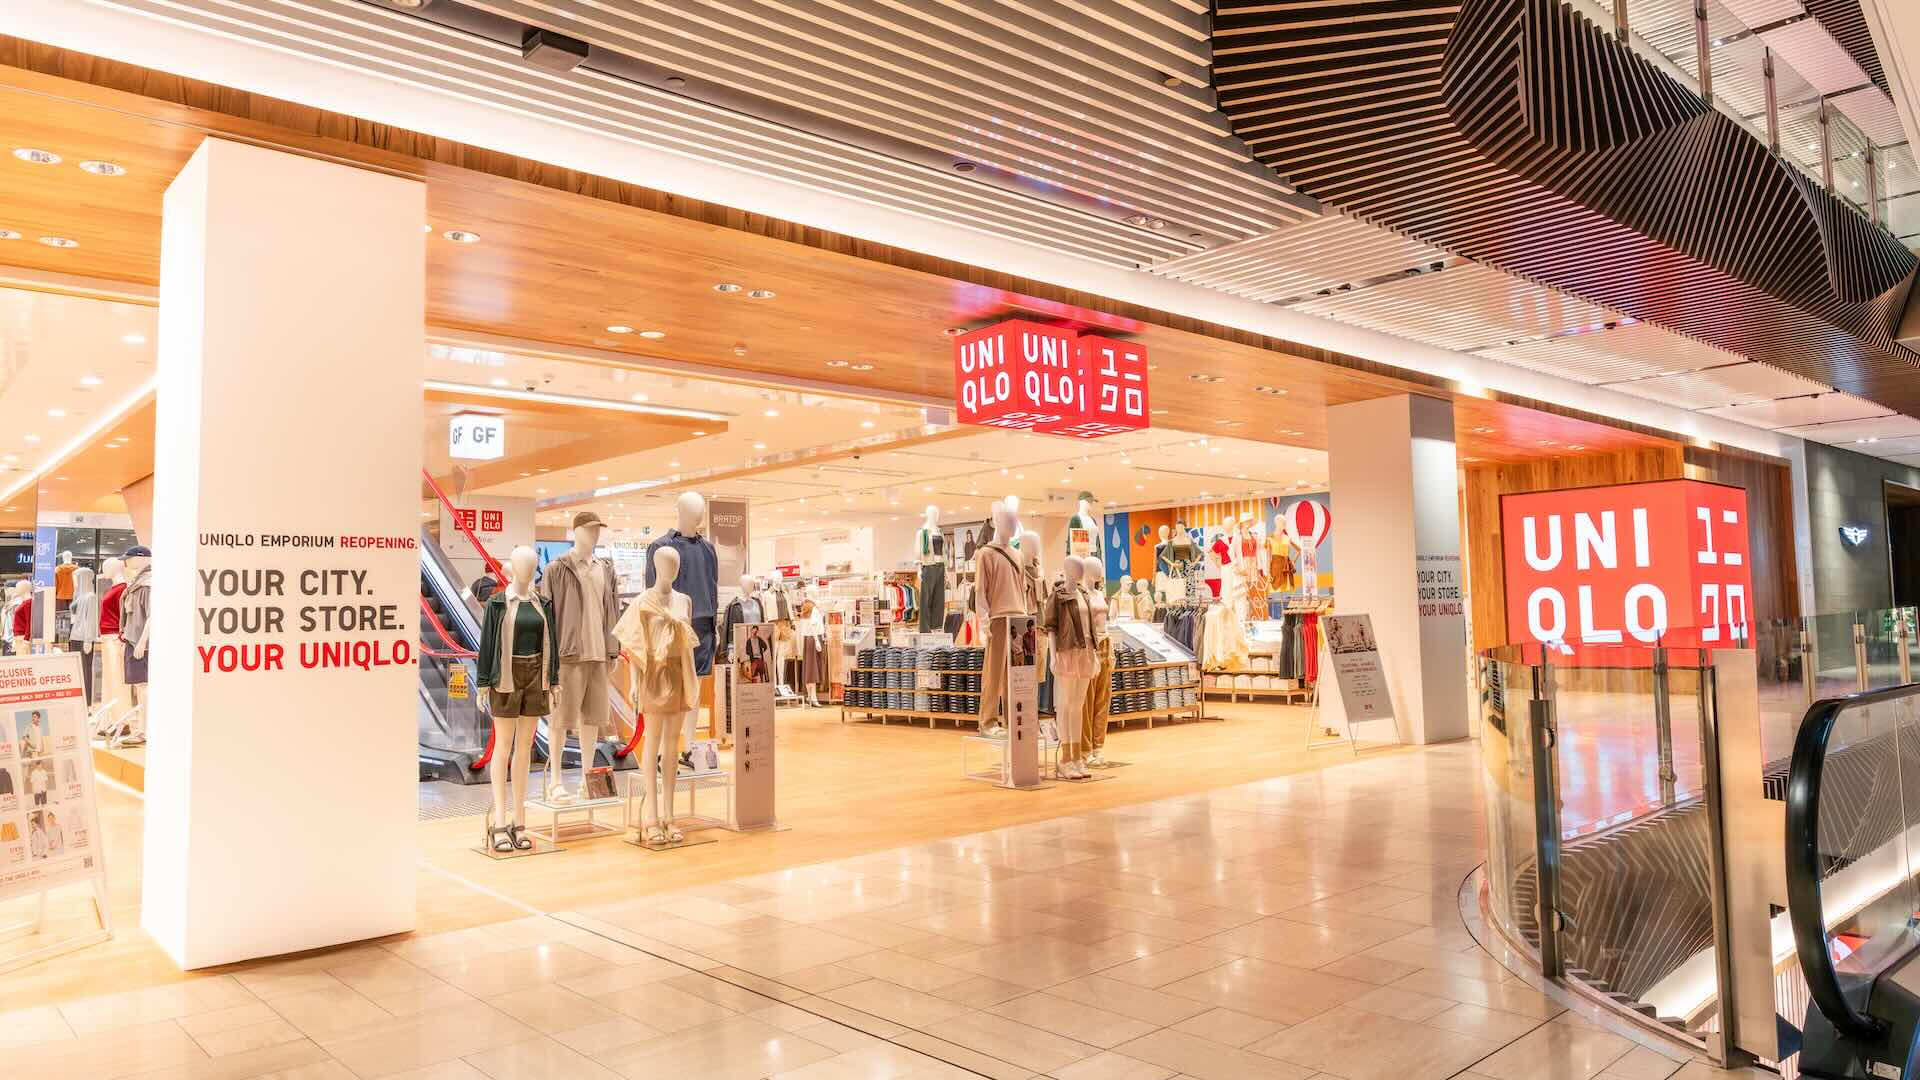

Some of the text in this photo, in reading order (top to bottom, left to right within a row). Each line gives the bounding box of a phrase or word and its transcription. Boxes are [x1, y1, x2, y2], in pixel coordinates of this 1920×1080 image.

[960, 334, 1005, 374] UNI
[1022, 332, 1069, 369] UNI
[961, 370, 1011, 415] QLO
[1024, 369, 1075, 408] QLO
[472, 426, 497, 444] GF
[483, 511, 500, 521] UNI
[483, 521, 501, 530] QLO
[199, 533, 419, 550] UNIQLO EMPORIUM REOPENING.
[1522, 506, 1651, 573] UNI
[198, 569, 374, 597] YOUR CITY.
[1416, 570, 1435, 583] YOUR
[1417, 587, 1436, 600] YOUR
[198, 605, 405, 635] YOUR STORE.
[1418, 603, 1437, 617] YOUR
[1526, 582, 1669, 656] QLO
[197, 639, 418, 673] YOUR UNIQLO.
[40, 674, 72, 686] OFFERS
